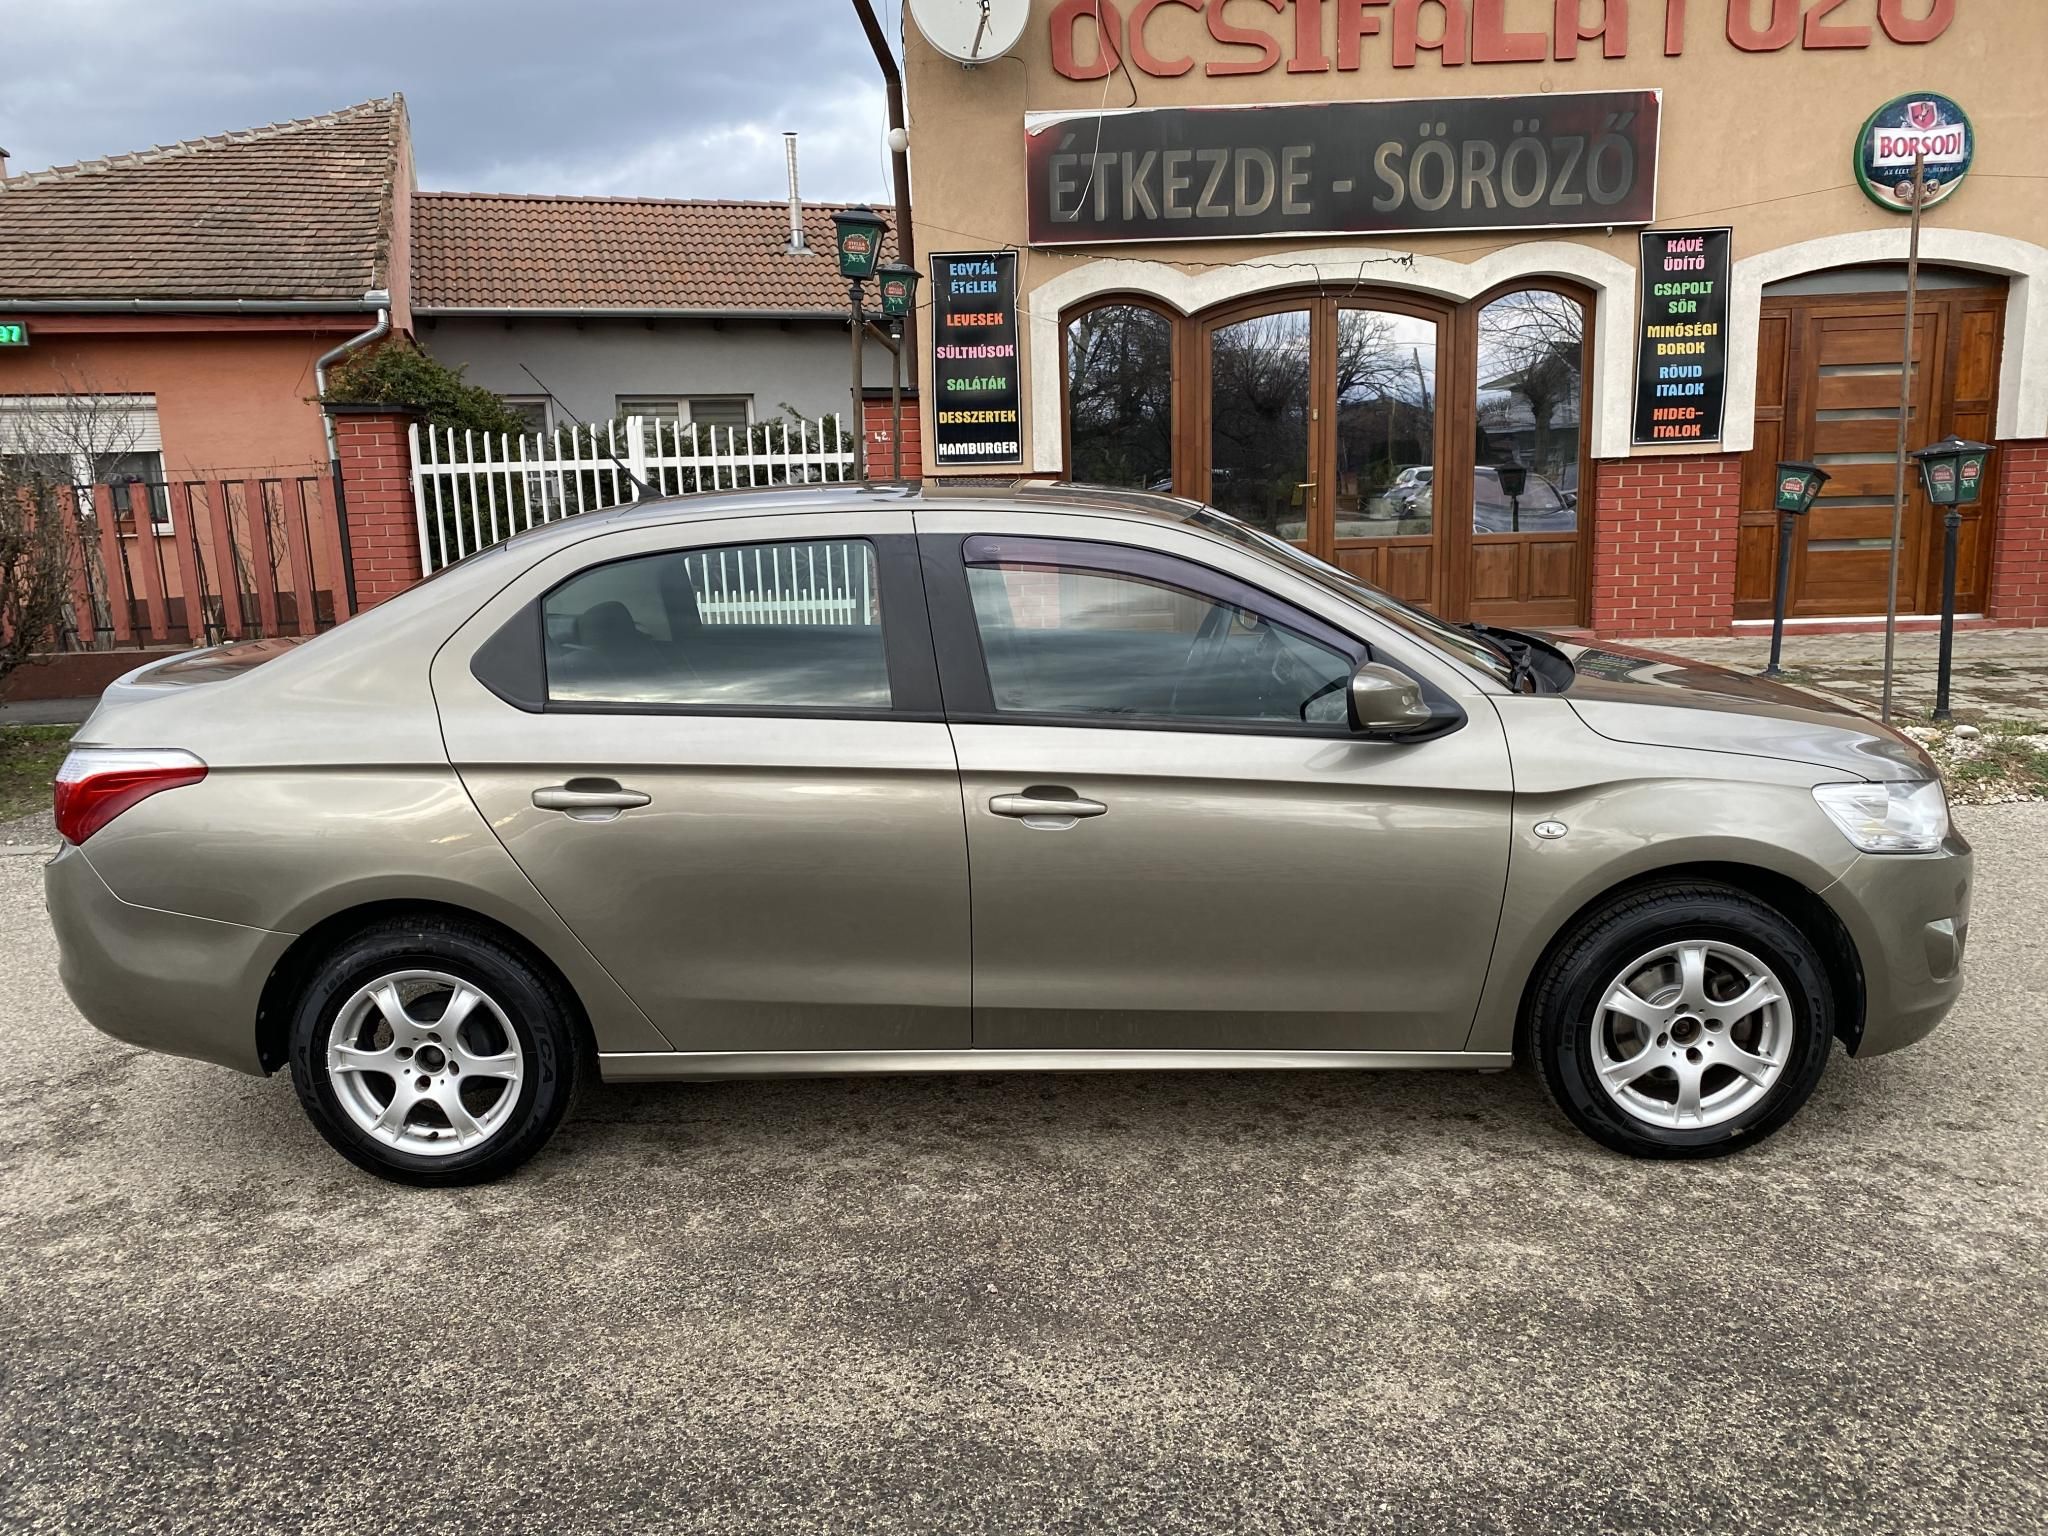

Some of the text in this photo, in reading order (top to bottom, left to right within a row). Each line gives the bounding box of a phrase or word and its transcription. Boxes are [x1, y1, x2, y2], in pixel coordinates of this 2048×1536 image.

[1880, 132, 1962, 158] BORSODI
[1048, 111, 1640, 222] ÉTKEZDE - SÖRÖZŐ
[1667, 237, 1704, 253] KÁVÉ
[950, 262, 998, 276] EGYTÁL
[1663, 255, 1705, 271] ÜDÍTŐ
[951, 280, 997, 294] ÉTELEK
[1654, 281, 1714, 296] CSAPOLT
[1668, 299, 1697, 313] SÖR
[946, 312, 1003, 327] LEVESEK
[1647, 322, 1718, 338] MINŐSÉGI
[936, 344, 1014, 359] SÜLTHÚSOK
[1657, 341, 1705, 356] BOROK
[1659, 364, 1703, 379] RÖVID
[947, 376, 1007, 391] SALÁTÁK
[1656, 382, 1704, 397] ITALOK
[939, 410, 1017, 424] DESSZERTEK
[1653, 407, 1704, 421] HIDEG-
[1653, 424, 1701, 438] ITALOK
[938, 441, 1018, 456] HAMBURGER
